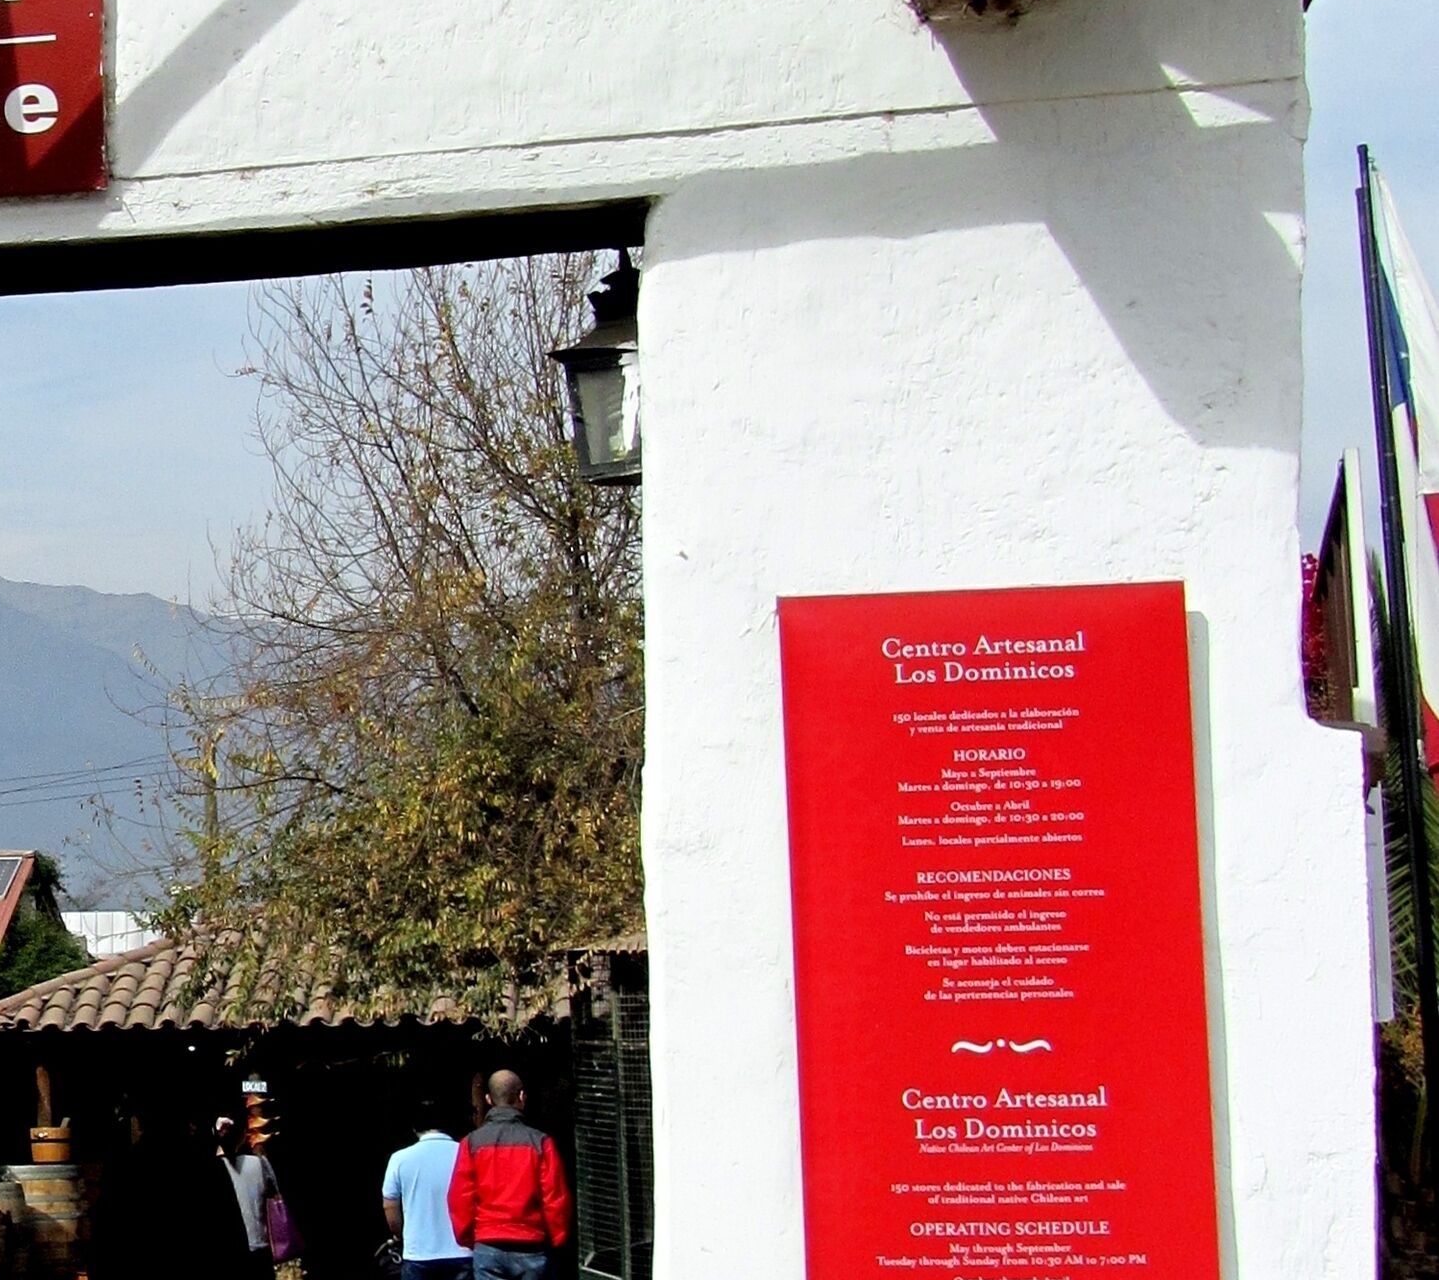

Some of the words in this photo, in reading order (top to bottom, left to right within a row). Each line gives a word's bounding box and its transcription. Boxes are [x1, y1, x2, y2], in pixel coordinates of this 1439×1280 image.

[881, 637, 967, 659] Centro
[972, 631, 1085, 655] Artesanal
[894, 663, 937, 684] Los
[943, 660, 1075, 682] Dominicos
[892, 713, 912, 724] 150
[913, 710, 948, 722] locales
[948, 709, 999, 721] dedicados
[1008, 708, 1019, 719] la
[916, 725, 945, 734] venta
[945, 722, 959, 733] de
[1007, 719, 1063, 731] tradicional
[953, 747, 1026, 762] HORARIO
[941, 768, 969, 782] Mayo
[978, 766, 1037, 781] Septiembre
[897, 782, 933, 793] Martes
[993, 779, 1007, 790] de
[950, 800, 993, 812] Octubre
[1002, 799, 1031, 810] Abril
[897, 815, 933, 825] Martes
[993, 812, 1007, 823] de
[938, 834, 973, 846] locales
[973, 833, 1040, 847] parcialmente
[1041, 832, 1083, 843] abiertos
[916, 868, 1072, 884] RECOMENDACIONES
[884, 891, 897, 903] Se
[941, 889, 952, 901] el
[953, 891, 991, 903] ingreso
[992, 888, 1006, 899] de
[1007, 887, 1053, 899] animales
[1071, 889, 1105, 897] correa
[924, 911, 941, 925] No
[963, 909, 1016, 924] permitido
[1016, 909, 1027, 920] el
[1029, 910, 1067, 922] ingreso
[930, 923, 944, 934] de
[944, 922, 1003, 933] vendedores
[1003, 920, 1062, 932] ambulantes
[905, 944, 953, 955] Bicicletas
[961, 946, 993, 954] motos
[994, 943, 1027, 954] deben
[1028, 943, 1090, 953] estacionarse
[927, 959, 941, 967] en
[942, 956, 969, 970] lugar
[970, 955, 1023, 966] habilitado
[1023, 954, 1034, 965] al
[1035, 957, 1068, 965] acceso
[942, 977, 956, 988] Se
[956, 977, 1000, 990] aconseja
[1001, 976, 1012, 987] el
[1012, 975, 1055, 987] cuidado
[923, 990, 938, 1001] de
[938, 990, 953, 1000] las
[954, 988, 1019, 1003] pertenencias
[1020, 987, 1074, 1002] personales
[902, 1088, 988, 1110] Centro
[993, 1085, 1108, 1108] Artesanal
[915, 1118, 958, 1140] Los
[964, 1118, 1097, 1139] Dominicos
[890, 1183, 910, 1194] 150
[911, 1184, 942, 1192] stores
[942, 1181, 993, 1192] dedicated
[993, 1183, 1006, 1192] to
[1006, 1181, 1024, 1192] the
[1025, 1180, 1083, 1191] fabrication
[1084, 1179, 1105, 1190] and
[1106, 1179, 1127, 1190] sale
[927, 1194, 941, 1205] of
[940, 1193, 996, 1205] traditional
[997, 1194, 1029, 1204] native
[1030, 1192, 1072, 1204] Chilean
[1073, 1195, 1089, 1203] art
[909, 1222, 1011, 1237] OPERATING
[1014, 1220, 1110, 1236] SCHEDULE
[949, 1243, 970, 1255] May
[972, 1242, 1015, 1255] through
[1015, 1242, 1072, 1254] September
[875, 1255, 918, 1269] Tuesday
[918, 1255, 961, 1269] through
[962, 1253, 1000, 1268] Sunday
[1000, 1253, 1029, 1266] from
[1064, 1254, 1084, 1265] AM
[1085, 1257, 1098, 1265] to
[1128, 1254, 1147, 1265] PM
